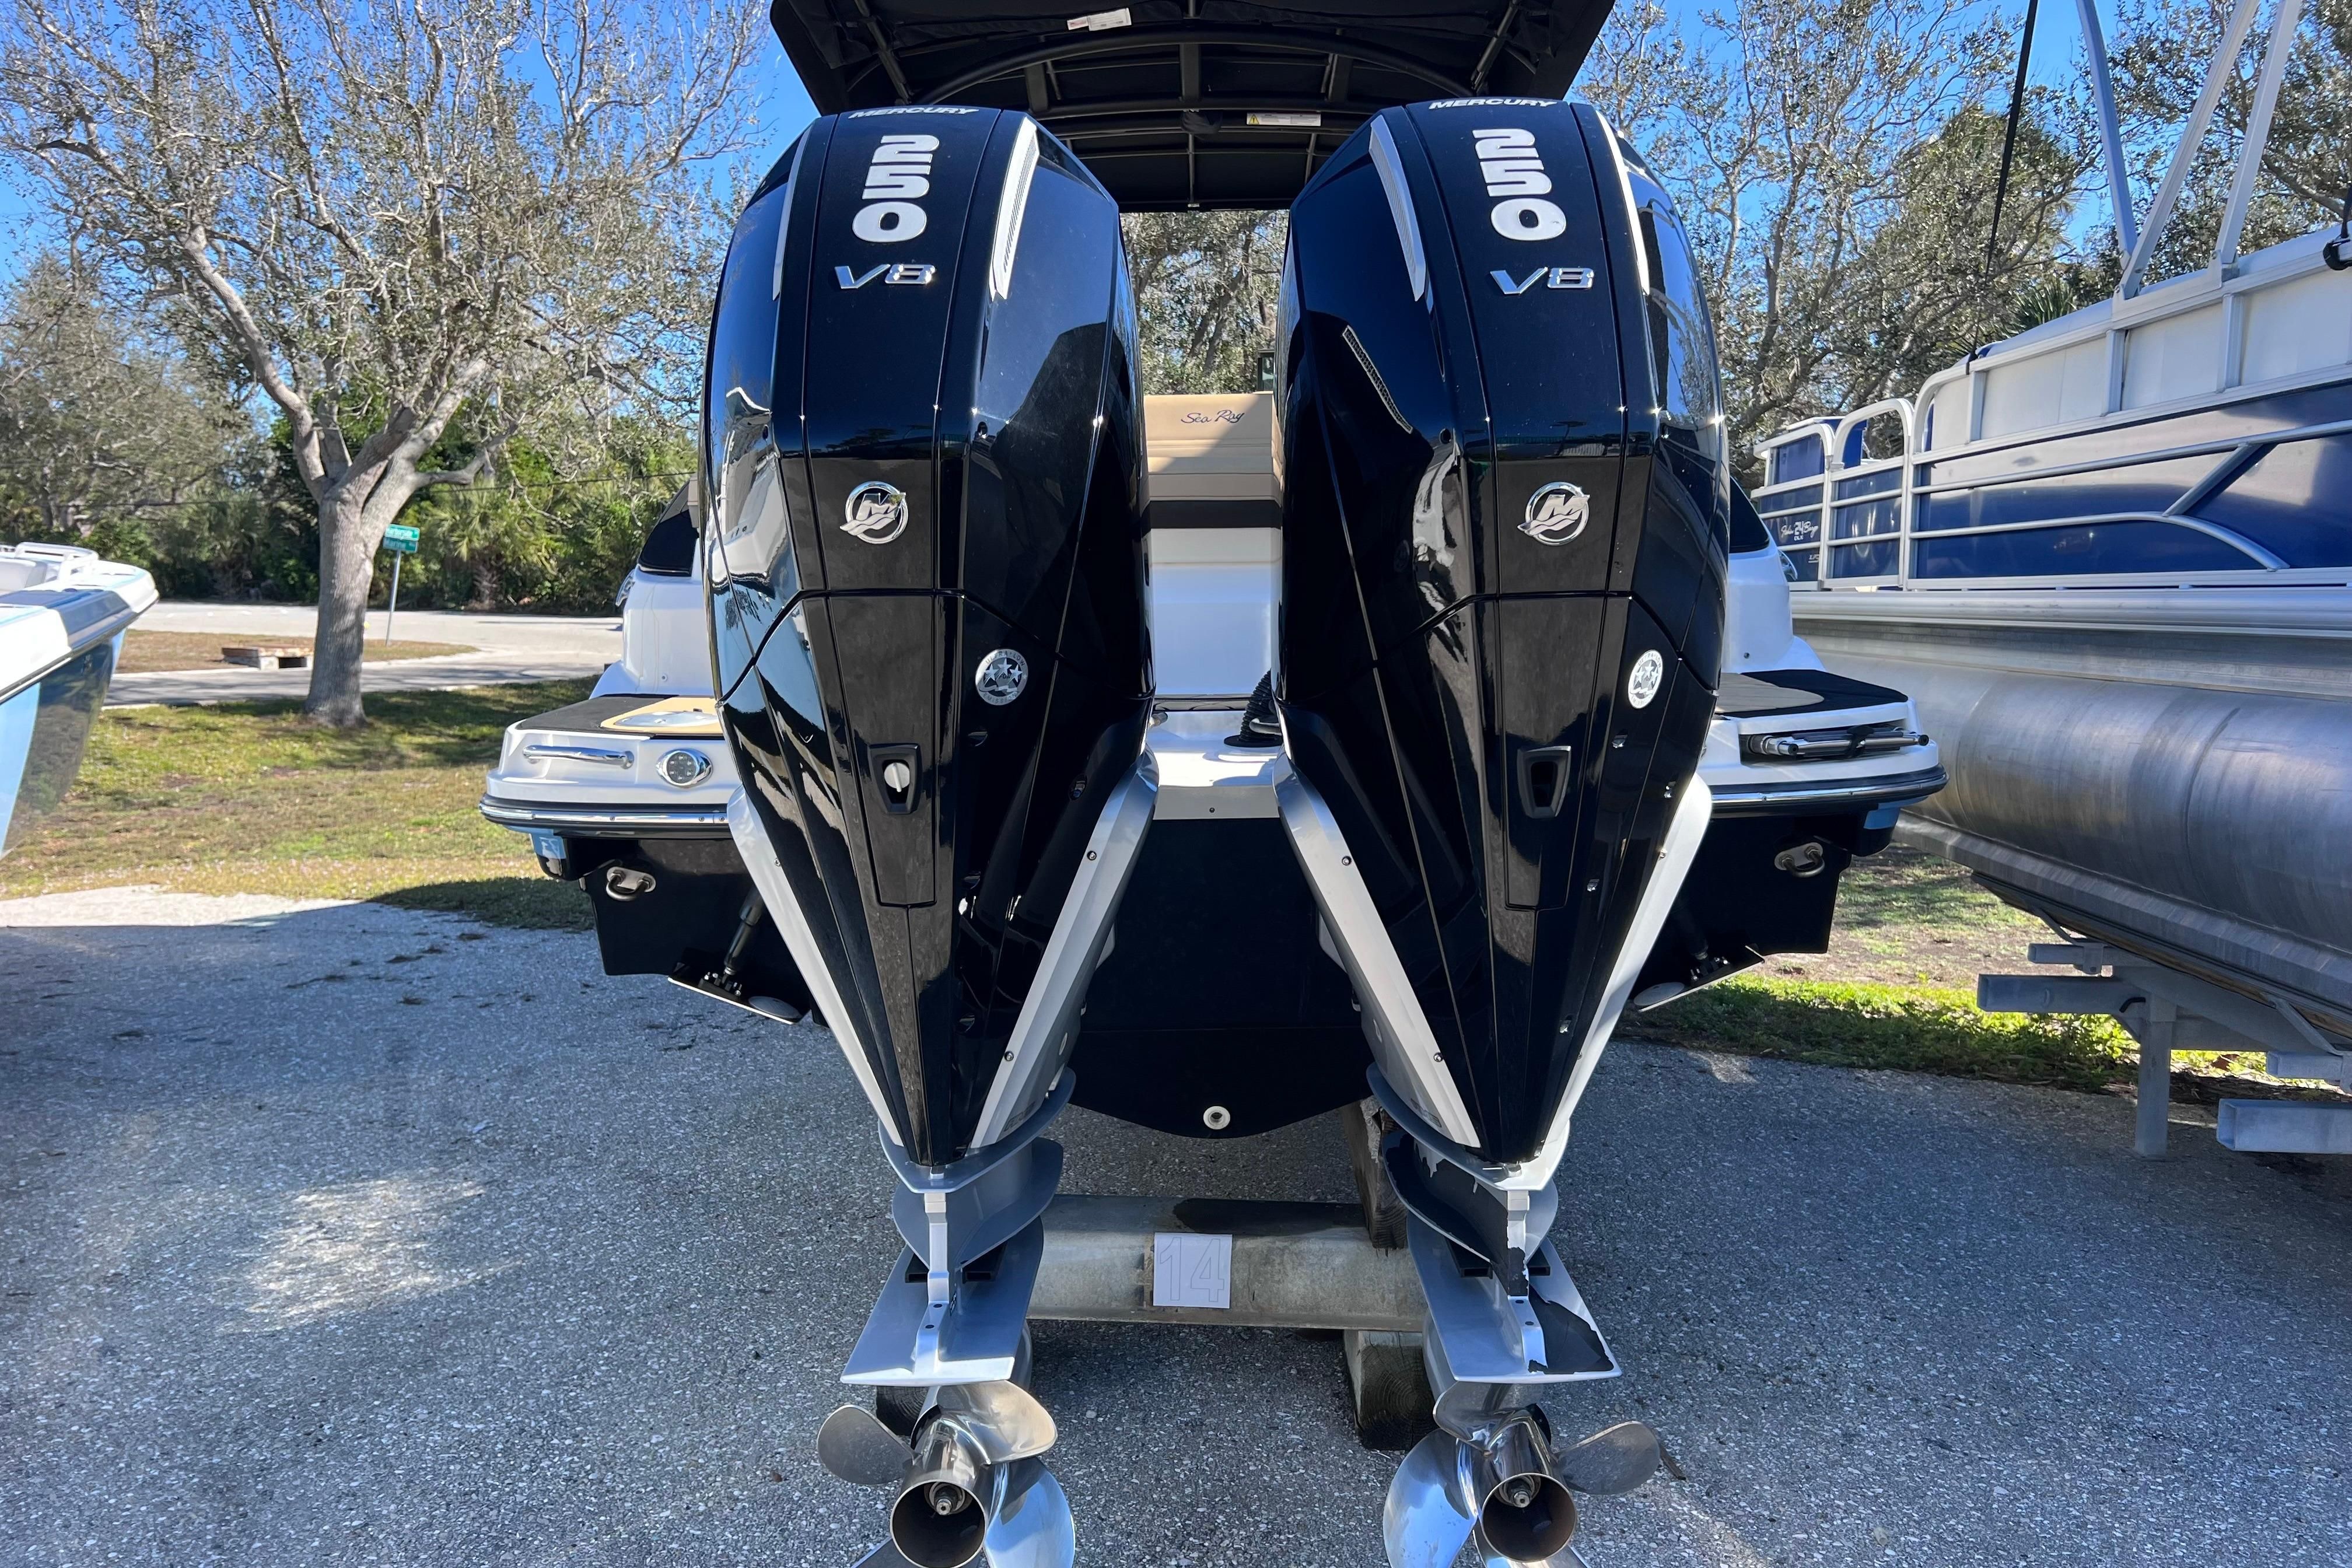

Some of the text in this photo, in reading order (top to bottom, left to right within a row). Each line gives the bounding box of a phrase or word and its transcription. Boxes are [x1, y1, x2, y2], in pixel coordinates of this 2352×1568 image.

[848, 107, 979, 119] MERCURY
[1429, 98, 1558, 110] MERCURY
[852, 134, 940, 243] 250
[1472, 128, 1567, 241] 250
[834, 264, 936, 289] V8
[1490, 266, 1594, 295] V8
[1180, 410, 1245, 424] Sea Ray
[1160, 1237, 1225, 1302] 14
